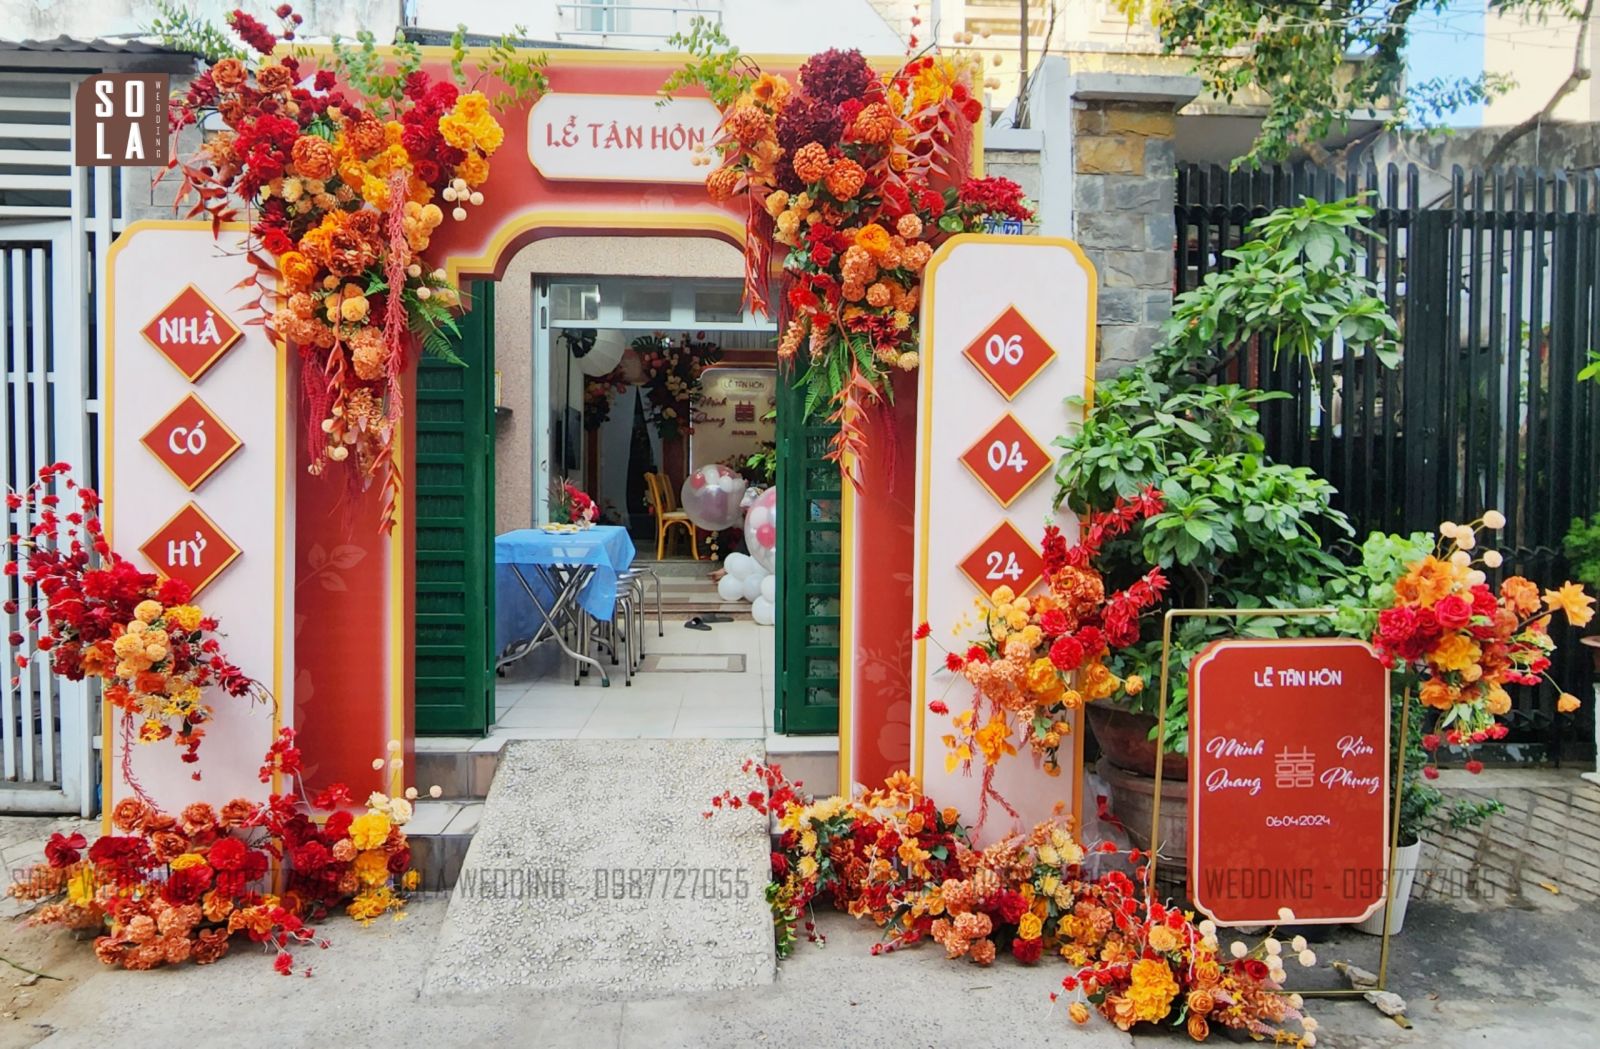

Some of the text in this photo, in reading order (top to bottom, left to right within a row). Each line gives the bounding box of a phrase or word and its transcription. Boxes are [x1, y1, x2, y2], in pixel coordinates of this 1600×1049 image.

[158, 310, 222, 345] NHÀ
[985, 334, 1024, 366] 06
[168, 420, 207, 456] CÓ
[987, 440, 1029, 473] 04
[167, 531, 208, 568] HỶ
[985, 551, 1024, 581] 24
[1254, 666, 1342, 687] LỄ TÂN HÔN
[1206, 736, 1265, 759] Minh
[1336, 735, 1374, 758] Kim
[1205, 767, 1262, 796] Quang
[1319, 766, 1380, 794] Phụng
